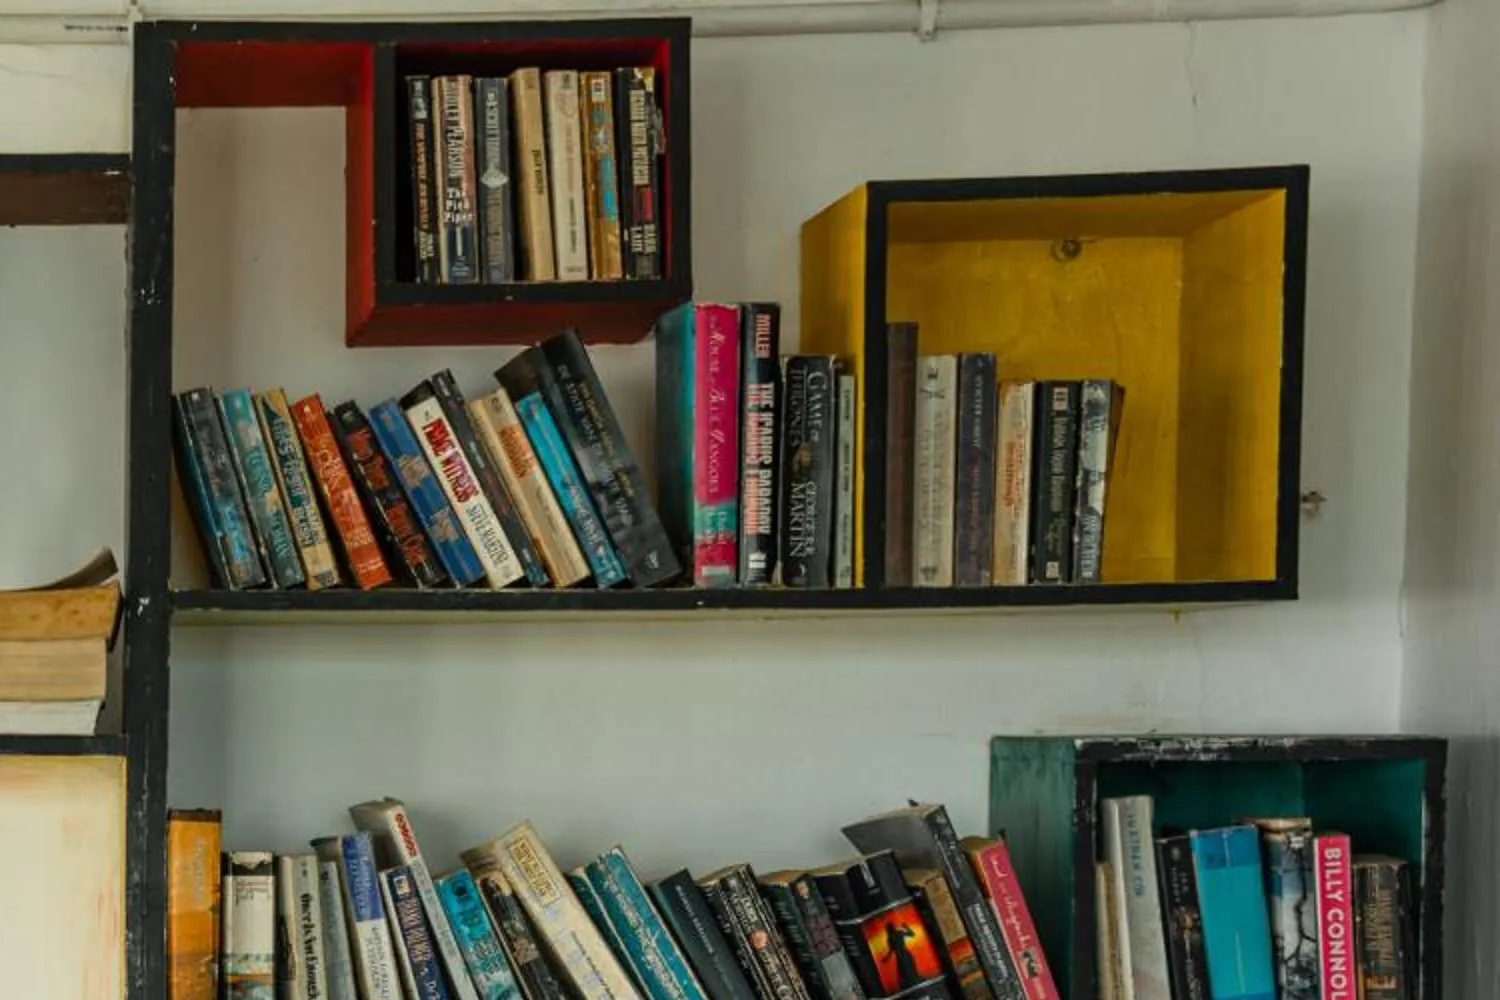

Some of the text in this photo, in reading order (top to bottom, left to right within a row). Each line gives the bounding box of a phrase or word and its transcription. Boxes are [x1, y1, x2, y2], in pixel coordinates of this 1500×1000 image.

[755, 314, 771, 358] MILLER
[746, 382, 773, 409] THE
[805, 370, 827, 428] GAME
[745, 412, 772, 464] ICARUS
[788, 481, 805, 558] MARTIN
[1323, 847, 1344, 902] BILLY
